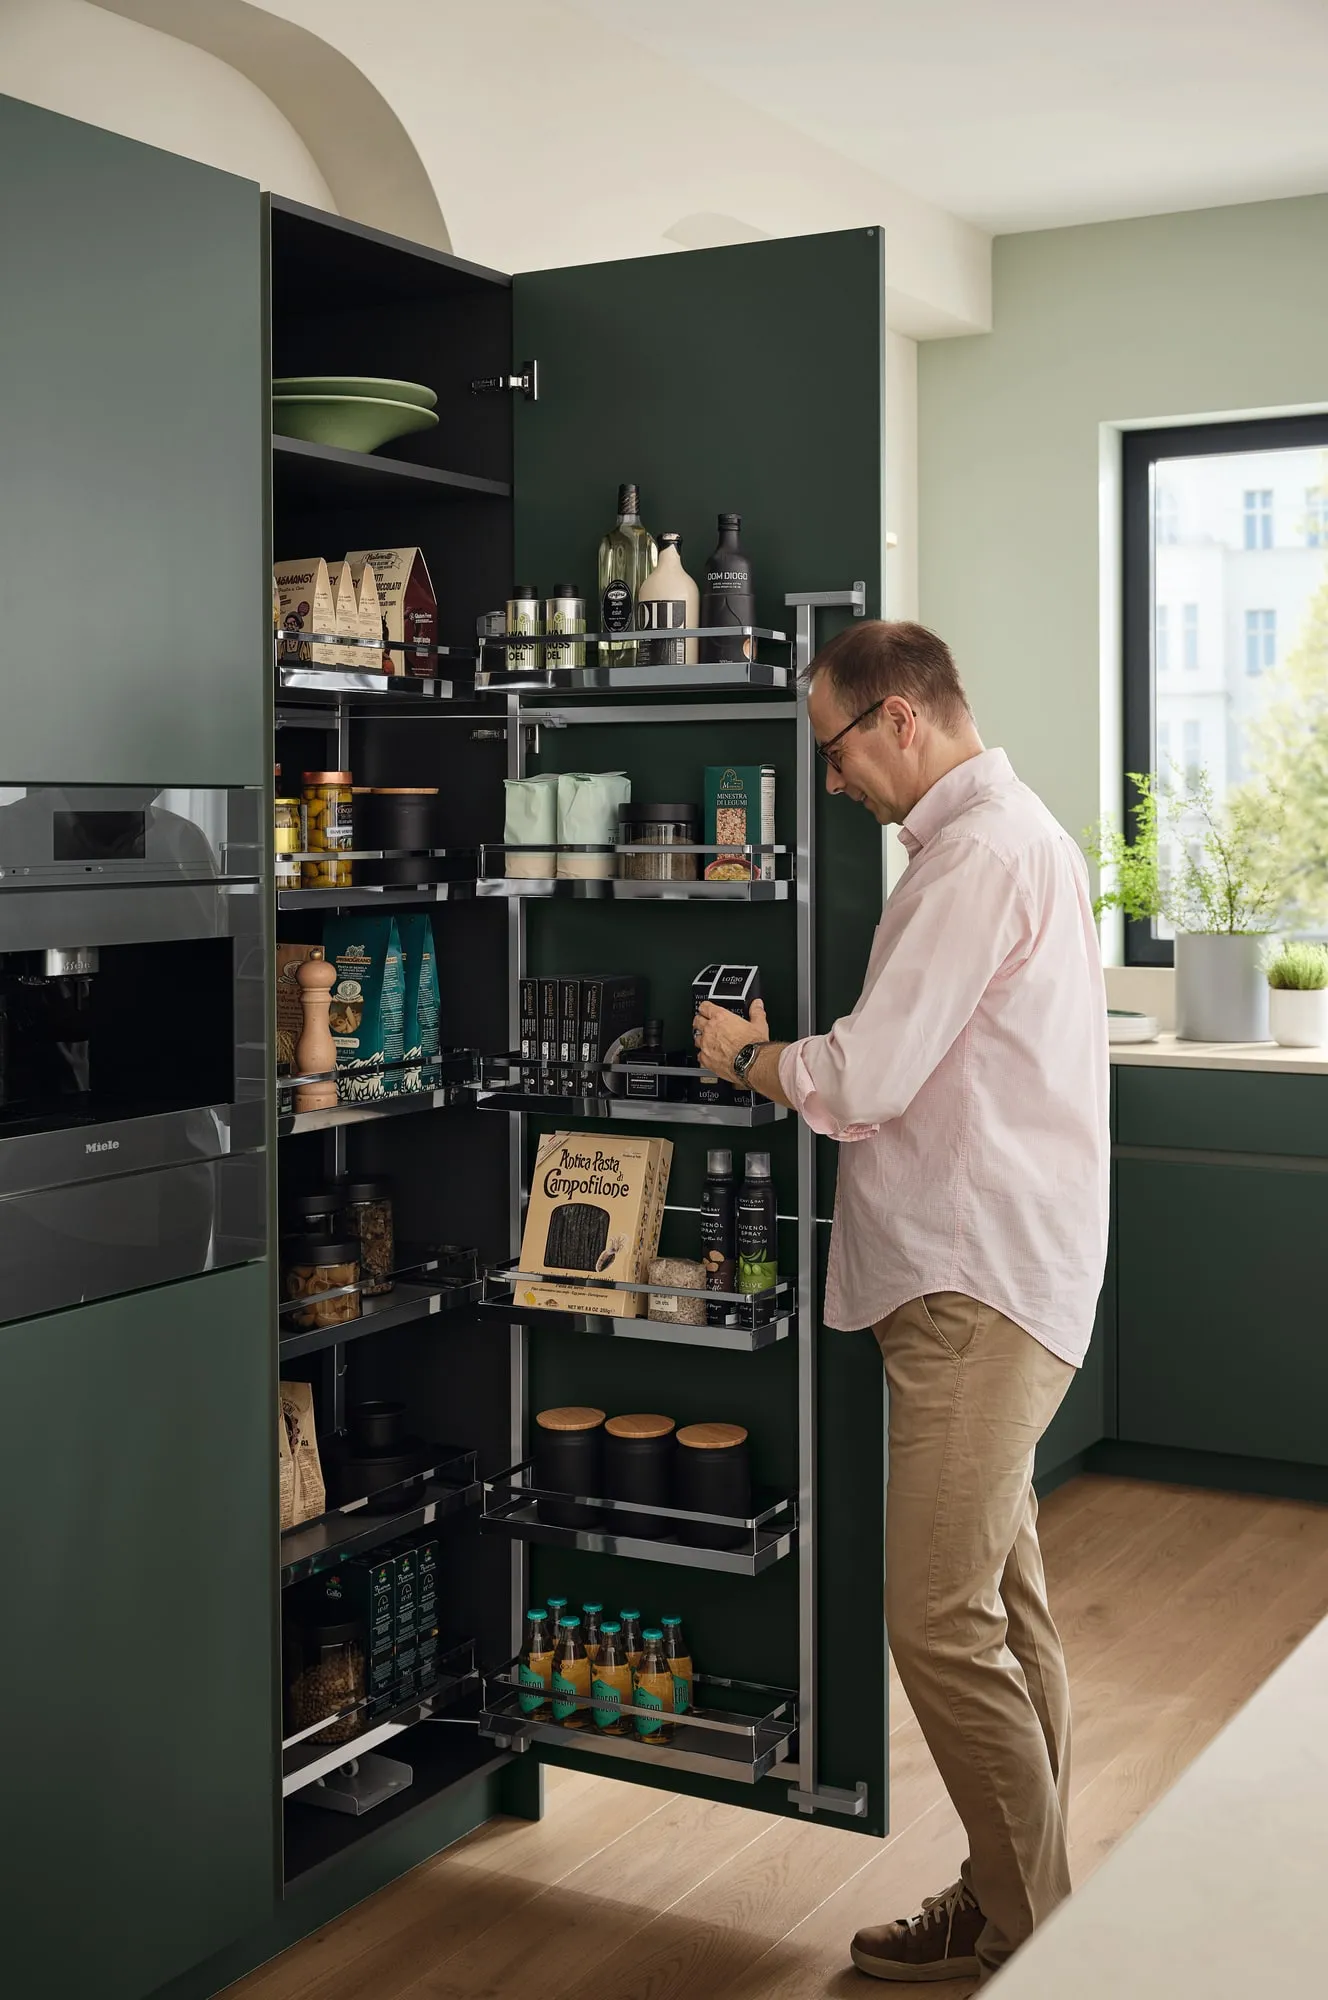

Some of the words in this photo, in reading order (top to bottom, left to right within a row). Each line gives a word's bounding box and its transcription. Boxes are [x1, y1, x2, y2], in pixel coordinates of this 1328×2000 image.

[707, 571, 723, 581] DOM
[724, 571, 748, 581] DIOGO
[508, 652, 525, 661] OEL
[85, 1140, 120, 1154] Miele
[559, 1149, 592, 1170] Antica
[592, 1151, 620, 1173] Pasta
[543, 1168, 629, 1200] Campofilone
